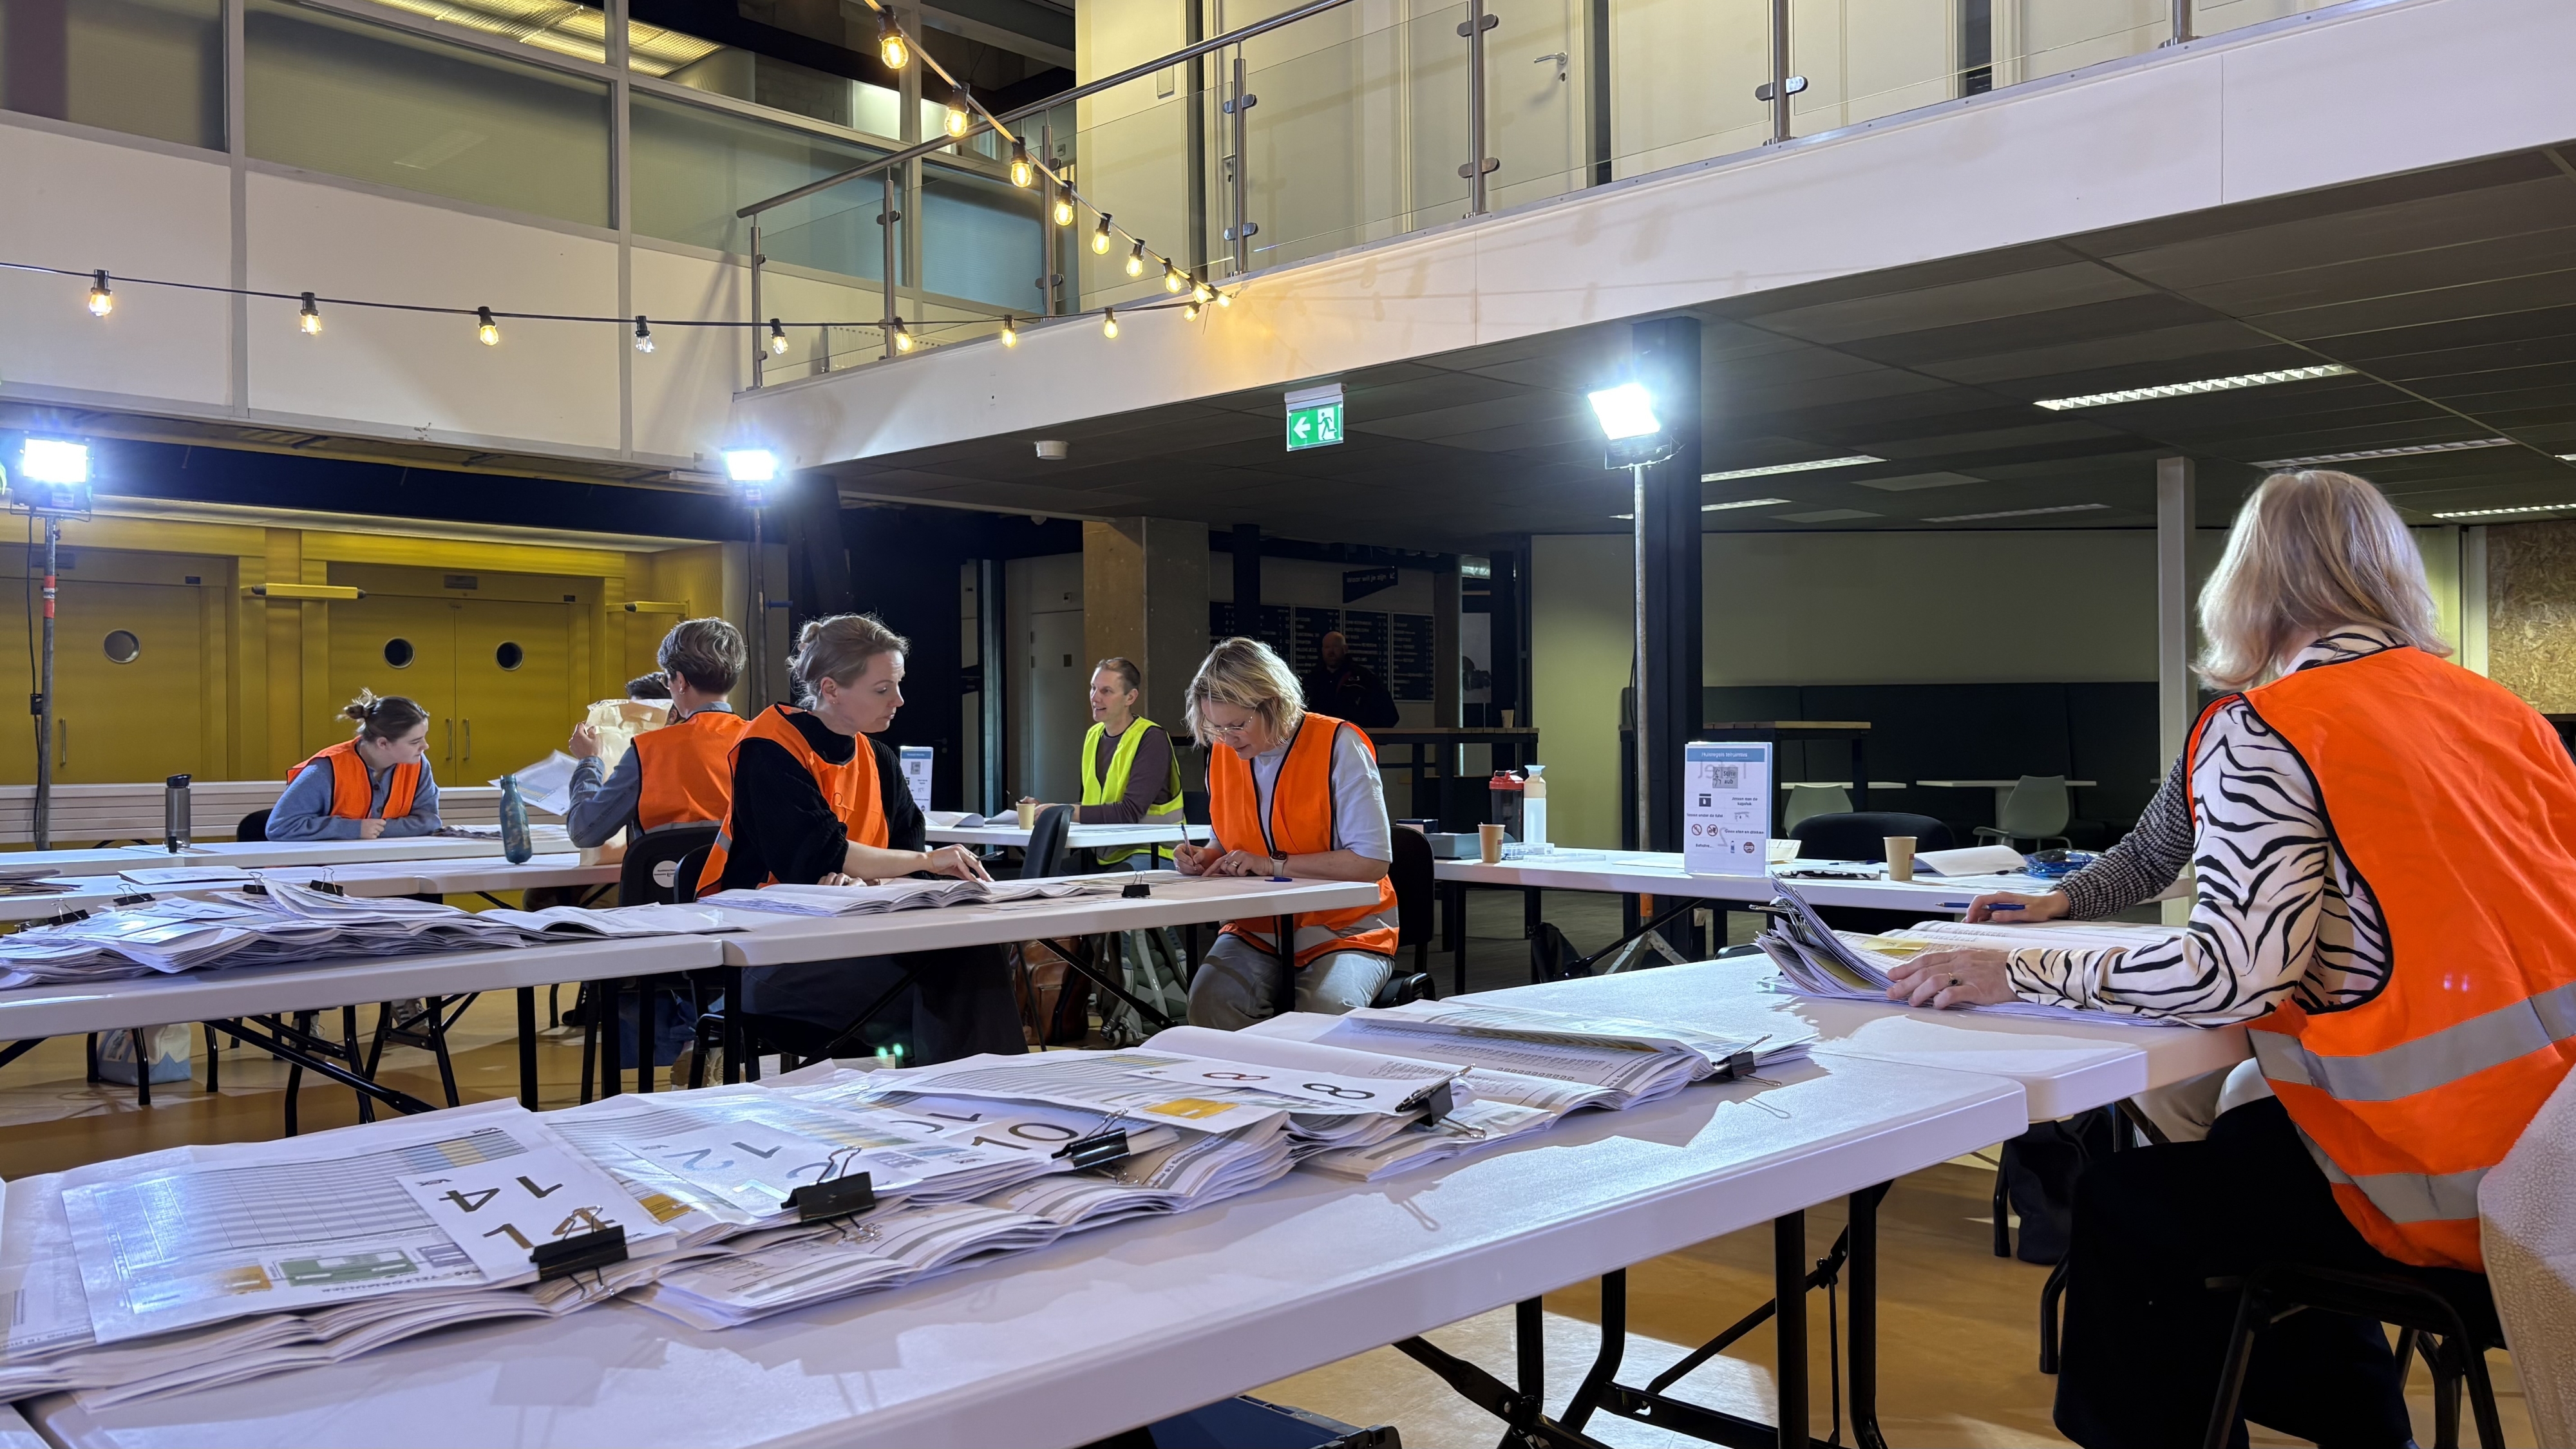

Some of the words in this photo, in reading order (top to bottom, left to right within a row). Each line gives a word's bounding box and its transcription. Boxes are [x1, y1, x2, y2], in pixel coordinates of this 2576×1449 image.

[1202, 1072, 1270, 1081] 8
[1302, 1083, 1375, 1100] 8
[971, 1122, 1079, 1150] 10
[662, 1141, 782, 1171] 12
[438, 1175, 564, 1213] 14
[482, 1208, 616, 1250] 14
